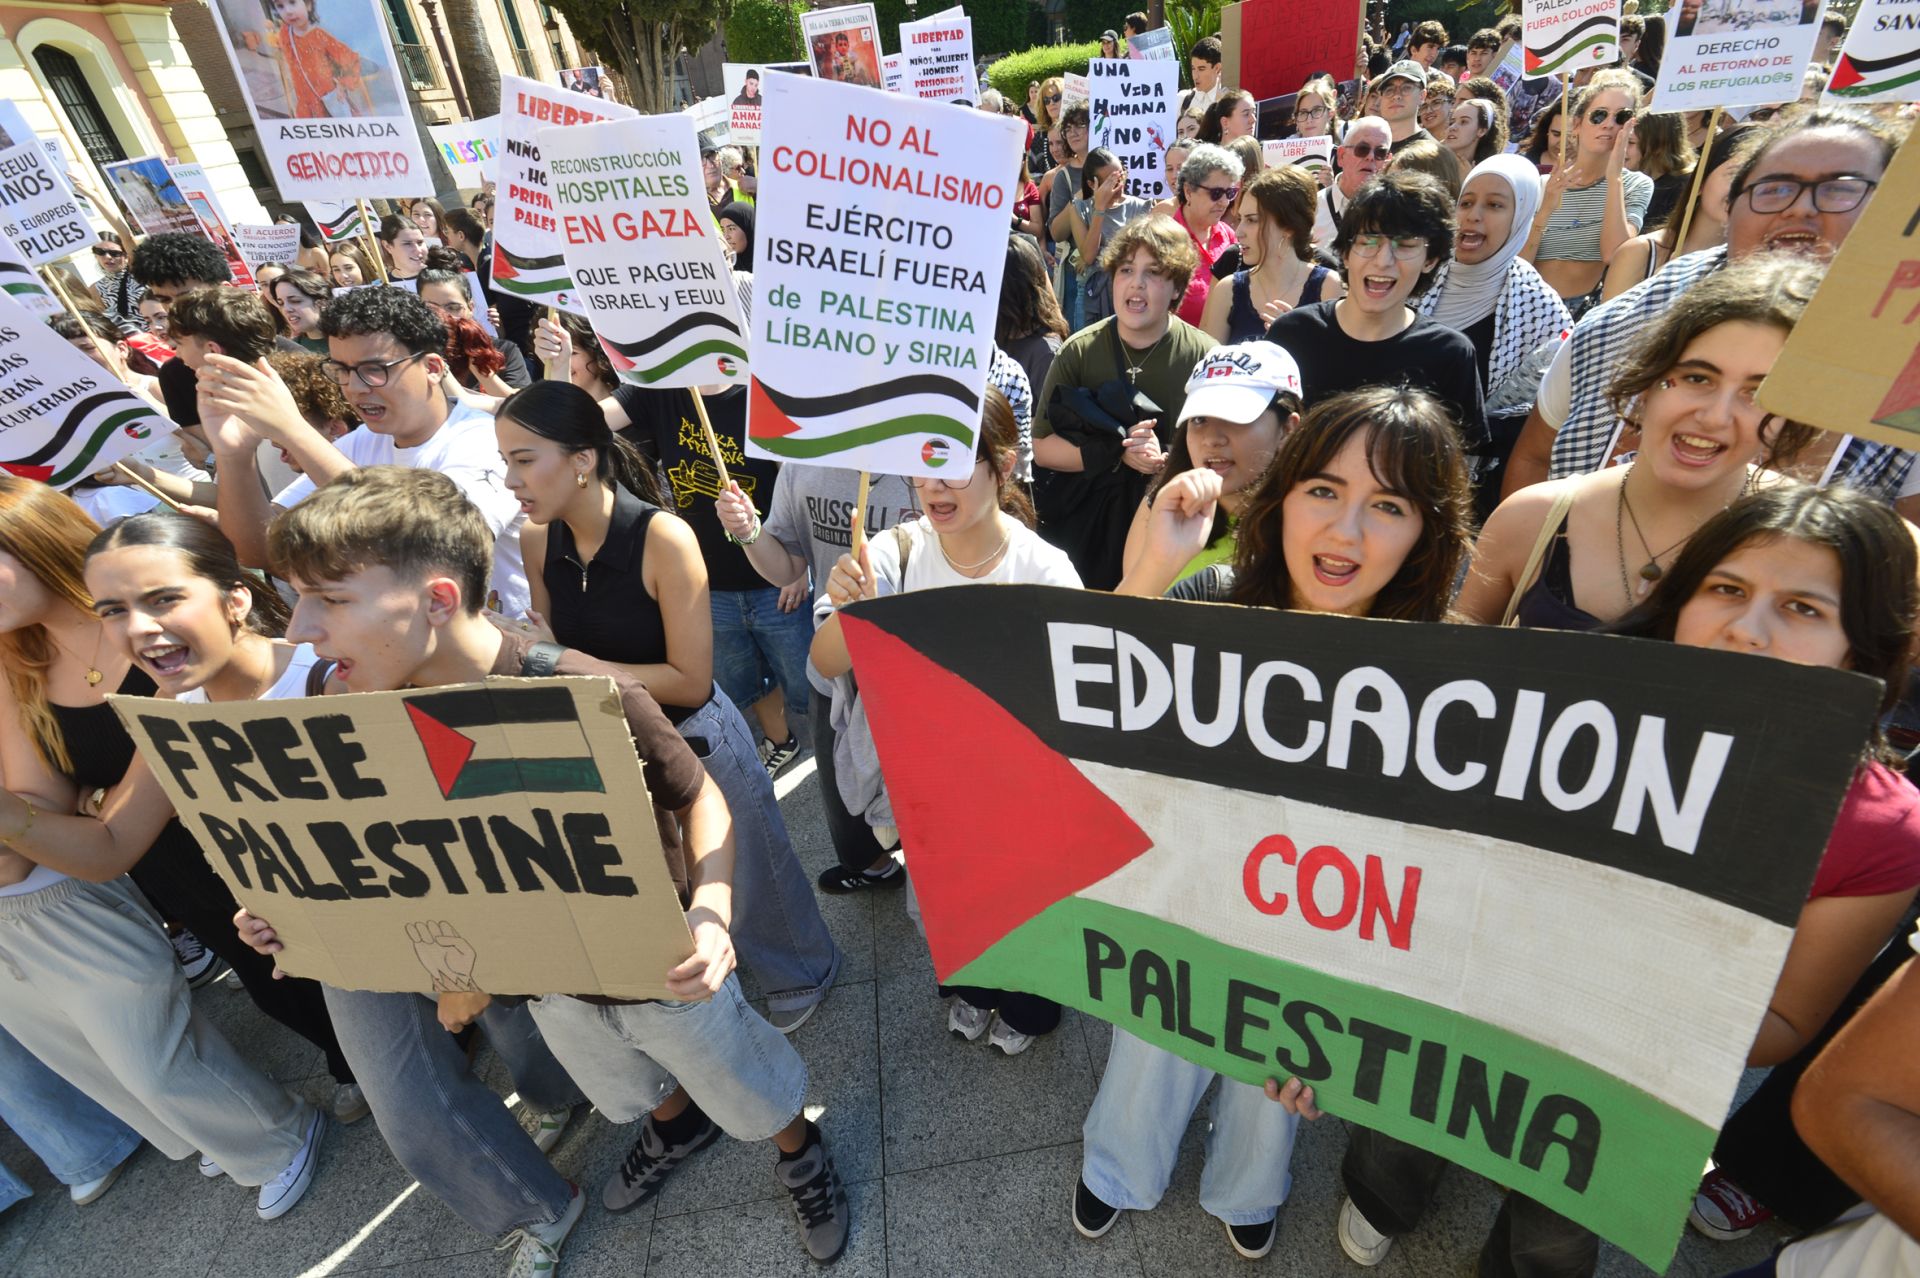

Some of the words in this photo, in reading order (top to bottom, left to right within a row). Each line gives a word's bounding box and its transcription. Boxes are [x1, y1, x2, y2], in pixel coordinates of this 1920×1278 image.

[1526, 15, 1559, 31] FUERA
[1562, 0, 1616, 22] COLONOS
[1873, 13, 1920, 32] SAN
[912, 29, 964, 44] LIBERTAD
[1697, 37, 1780, 56] DERECHO
[909, 56, 935, 66] NIÑOS,
[936, 53, 969, 63] MUJERES
[922, 65, 959, 76] HOMBRES
[1094, 62, 1130, 77] UNA
[1677, 64, 1696, 75] AL
[1700, 57, 1769, 73] RETORNO
[1772, 55, 1793, 66] DE
[1121, 82, 1164, 97] VIDA
[1668, 81, 1696, 93] LOS
[1698, 72, 1793, 90] REFUGIAD@S
[1094, 98, 1167, 116] HUMANA
[280, 123, 399, 140] ASESINADA
[847, 115, 892, 147] NO
[899, 126, 939, 156] AL
[1115, 128, 1141, 144] NO
[1267, 143, 1284, 151] VIVA
[1286, 139, 1326, 149] PALESTINA
[1283, 147, 1307, 157] LIBRE
[287, 151, 409, 181] GENOCIDIO
[551, 149, 682, 175] RECONSTRUCCIÓN
[556, 175, 690, 204] HOSPITALES
[772, 146, 1004, 210] COLIONALISMO
[21, 202, 77, 231] EUROPEOS
[563, 215, 607, 244] EN
[612, 208, 705, 242] GAZA
[806, 204, 953, 250] EJÉRCITO
[258, 241, 297, 249] GENOCIDIO
[576, 267, 620, 287] QUE
[628, 261, 716, 284] PAGUEN
[767, 237, 885, 279] ISRAELÍ
[894, 258, 986, 294] FUERA
[589, 294, 655, 310] ISRAEL
[658, 295, 670, 312] y
[674, 288, 726, 306] EEUU
[767, 284, 801, 309] de
[820, 290, 975, 335] PALESTINA
[766, 317, 876, 357] LÍBANO
[883, 342, 900, 366] y
[908, 341, 978, 370] SIRIA
[1047, 622, 1734, 854] EDUCACION
[137, 713, 388, 802] FREE
[199, 808, 639, 901] PALESTINE
[1243, 834, 1421, 951] CON
[1083, 928, 1601, 1195] PALESTINA
